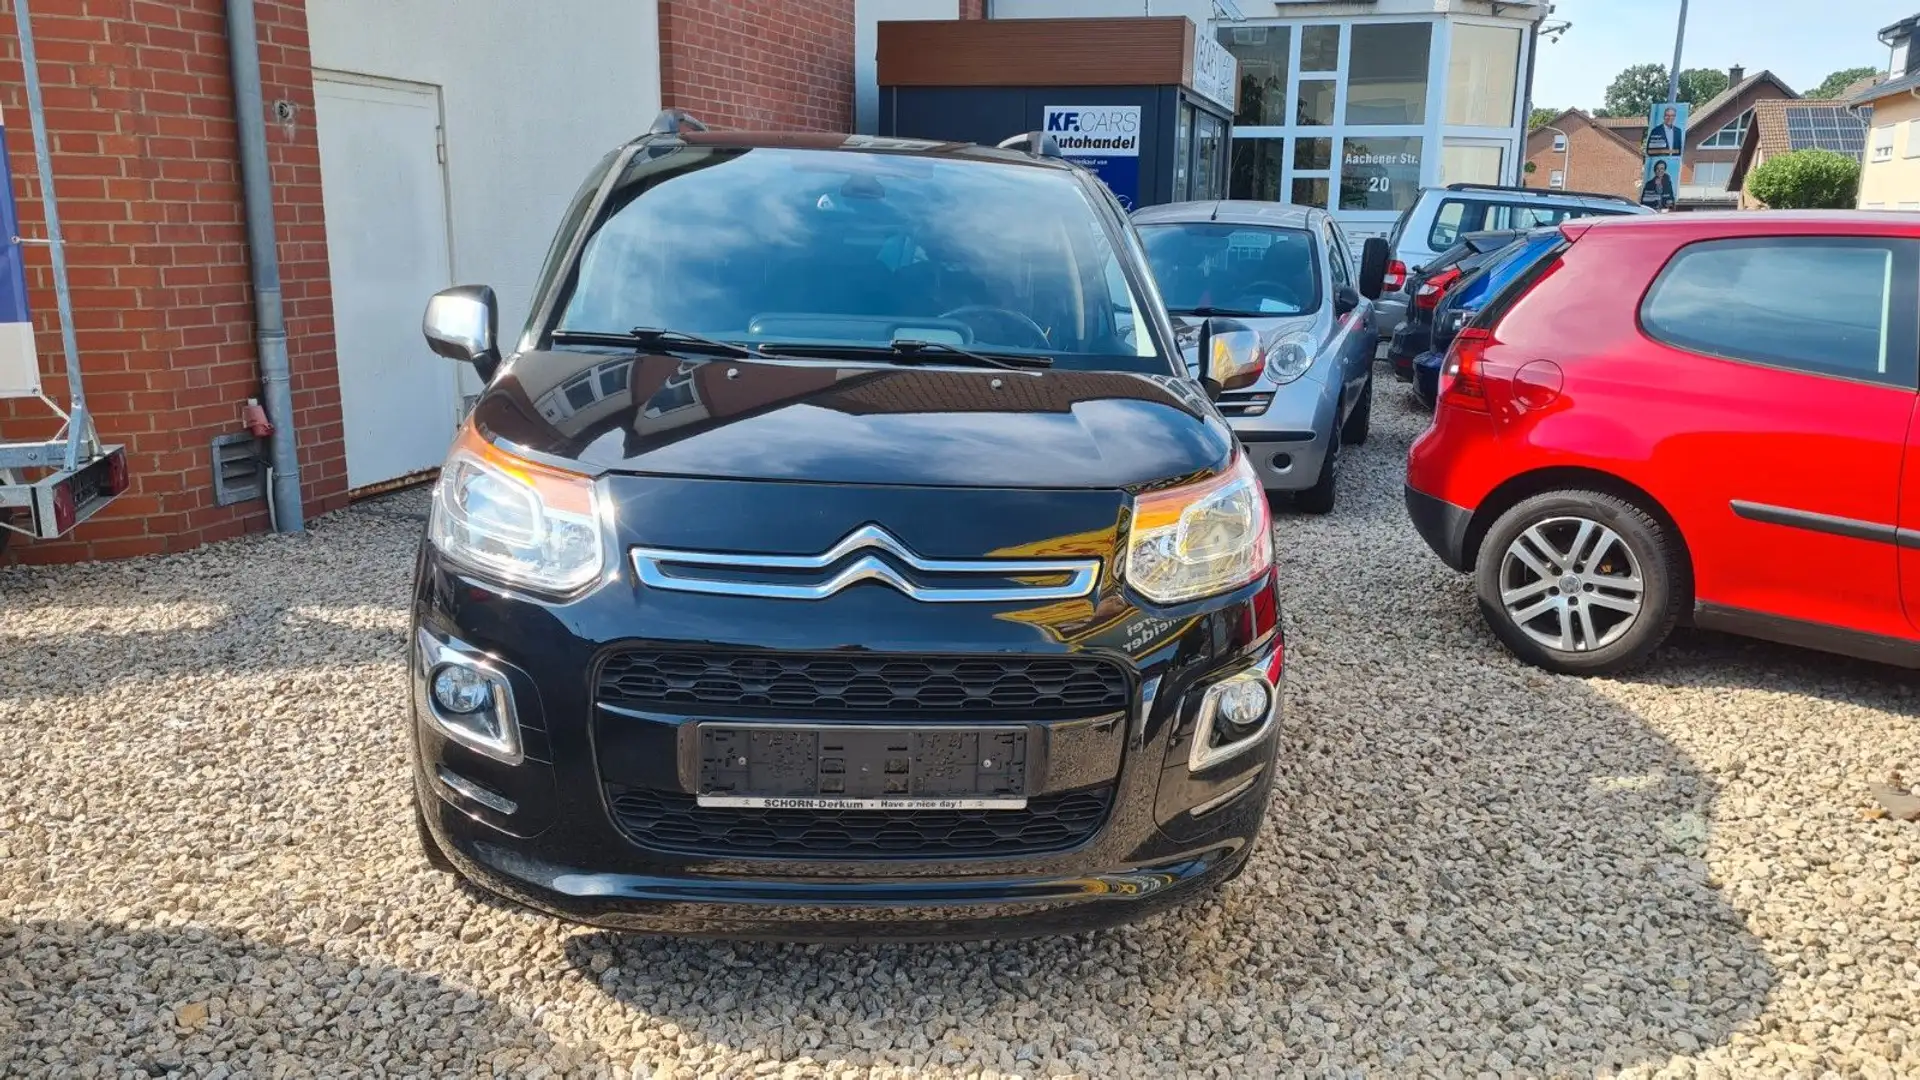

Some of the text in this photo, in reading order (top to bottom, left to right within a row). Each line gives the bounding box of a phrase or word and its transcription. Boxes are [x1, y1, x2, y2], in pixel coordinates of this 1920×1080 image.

[1047, 112, 1138, 132] KF.CARS
[1345, 153, 1419, 165] Aachener Str.
[1369, 177, 1390, 192] 20
[763, 799, 863, 808] SCHORN-Derkum
[881, 800, 904, 808] Have
[916, 800, 936, 808] nice
